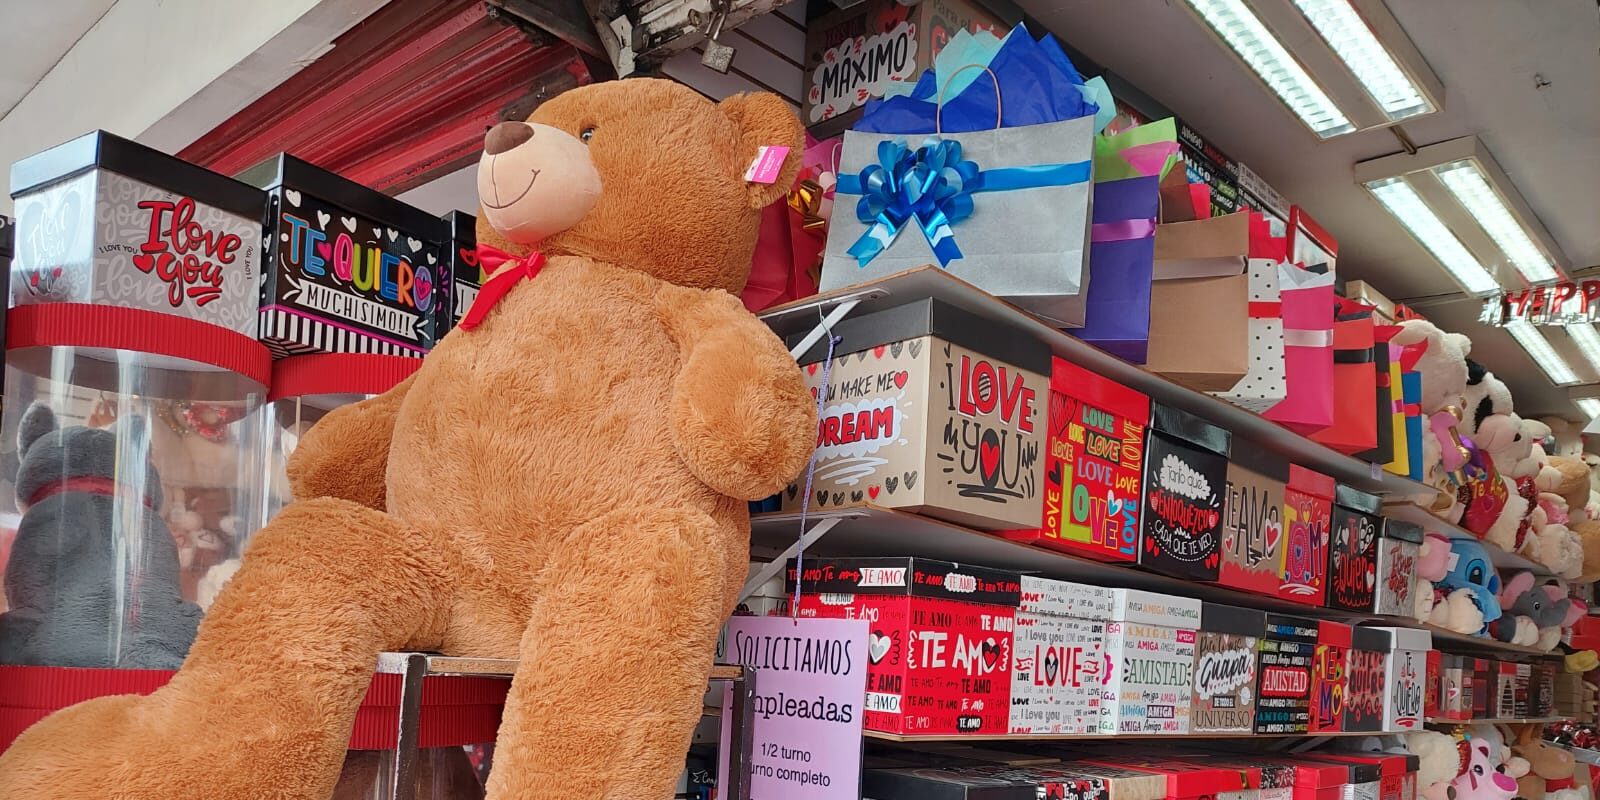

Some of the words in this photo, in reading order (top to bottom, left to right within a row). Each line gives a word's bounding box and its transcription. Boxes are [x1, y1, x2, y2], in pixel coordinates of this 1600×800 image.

[821, 32, 908, 104] MÁXIMO
[162, 197, 242, 265] love
[105, 244, 121, 253] LOVE
[122, 244, 138, 254] YOU
[281, 212, 327, 276] TE
[333, 232, 433, 312] QUIERO
[155, 252, 224, 308] you
[307, 283, 411, 336] MUCHISIMO!!
[839, 376, 871, 400] MAKE
[876, 370, 896, 394] ME
[945, 362, 956, 411] I
[957, 354, 1036, 435] LOVE
[1082, 405, 1114, 433] LOVE
[1051, 436, 1074, 462] LOVE
[1087, 434, 1122, 462] LOVE
[1122, 418, 1144, 471] LOVE
[961, 420, 1023, 490] YOU
[1078, 456, 1113, 487] LOVE
[1115, 473, 1139, 495] LOVE
[1225, 481, 1239, 531] TE
[1119, 498, 1137, 555] LOVE
[1154, 519, 1172, 548] CADA
[803, 569, 821, 581] AMO
[864, 568, 874, 584] TE
[877, 570, 902, 585] AMO
[914, 571, 924, 584] TE
[926, 575, 944, 586] AMO
[959, 576, 974, 591] AMO
[1020, 592, 1039, 602] LOVE
[844, 607, 855, 620] TE
[859, 604, 879, 622] AMO
[1143, 604, 1166, 616] AMIGA
[913, 610, 925, 625] TE
[928, 611, 951, 627] AMO
[981, 614, 991, 631] TE
[993, 616, 1013, 632] AMO
[1017, 618, 1033, 626] LOVE
[1091, 625, 1102, 633] LOVE
[1029, 629, 1047, 640] Love
[1049, 632, 1064, 645] you
[1127, 626, 1169, 639] AMIGA
[735, 630, 852, 676] SOLICITAMOS
[919, 631, 947, 669] TE
[952, 634, 1001, 676] AMO
[1137, 640, 1159, 650] AMIGA
[1280, 643, 1299, 653] AMIGO
[1034, 644, 1083, 687] LOVE
[1128, 659, 1187, 686] AMISTAD
[1405, 652, 1412, 676] TE
[878, 674, 902, 693] AMO
[961, 678, 970, 694] TE
[973, 679, 991, 694] AMO
[1017, 673, 1030, 681] LOVE
[1263, 669, 1307, 692] AMISTAD
[908, 695, 917, 706] TE
[918, 696, 934, 706] AMO
[1088, 688, 1099, 696] LOVE
[1397, 681, 1420, 717] QUIERO
[874, 694, 898, 711] AMO
[1148, 706, 1174, 718] AMIGA
[1270, 699, 1285, 707] AMIGO
[904, 715, 914, 729] TE
[916, 717, 929, 729] AMO
[960, 718, 967, 728] TE
[967, 718, 980, 728] AMO
[1025, 709, 1043, 720] Love
[1045, 711, 1060, 723] you
[1195, 711, 1250, 727] UNIVERSO
[1259, 712, 1290, 721] AMIGO
[1087, 725, 1096, 733] LOVE
[1120, 721, 1141, 732] AMIGA
[1267, 724, 1284, 732] AMIGO
[761, 742, 778, 757] 1/2
[781, 743, 811, 762] turno
[776, 767, 831, 787] completo
